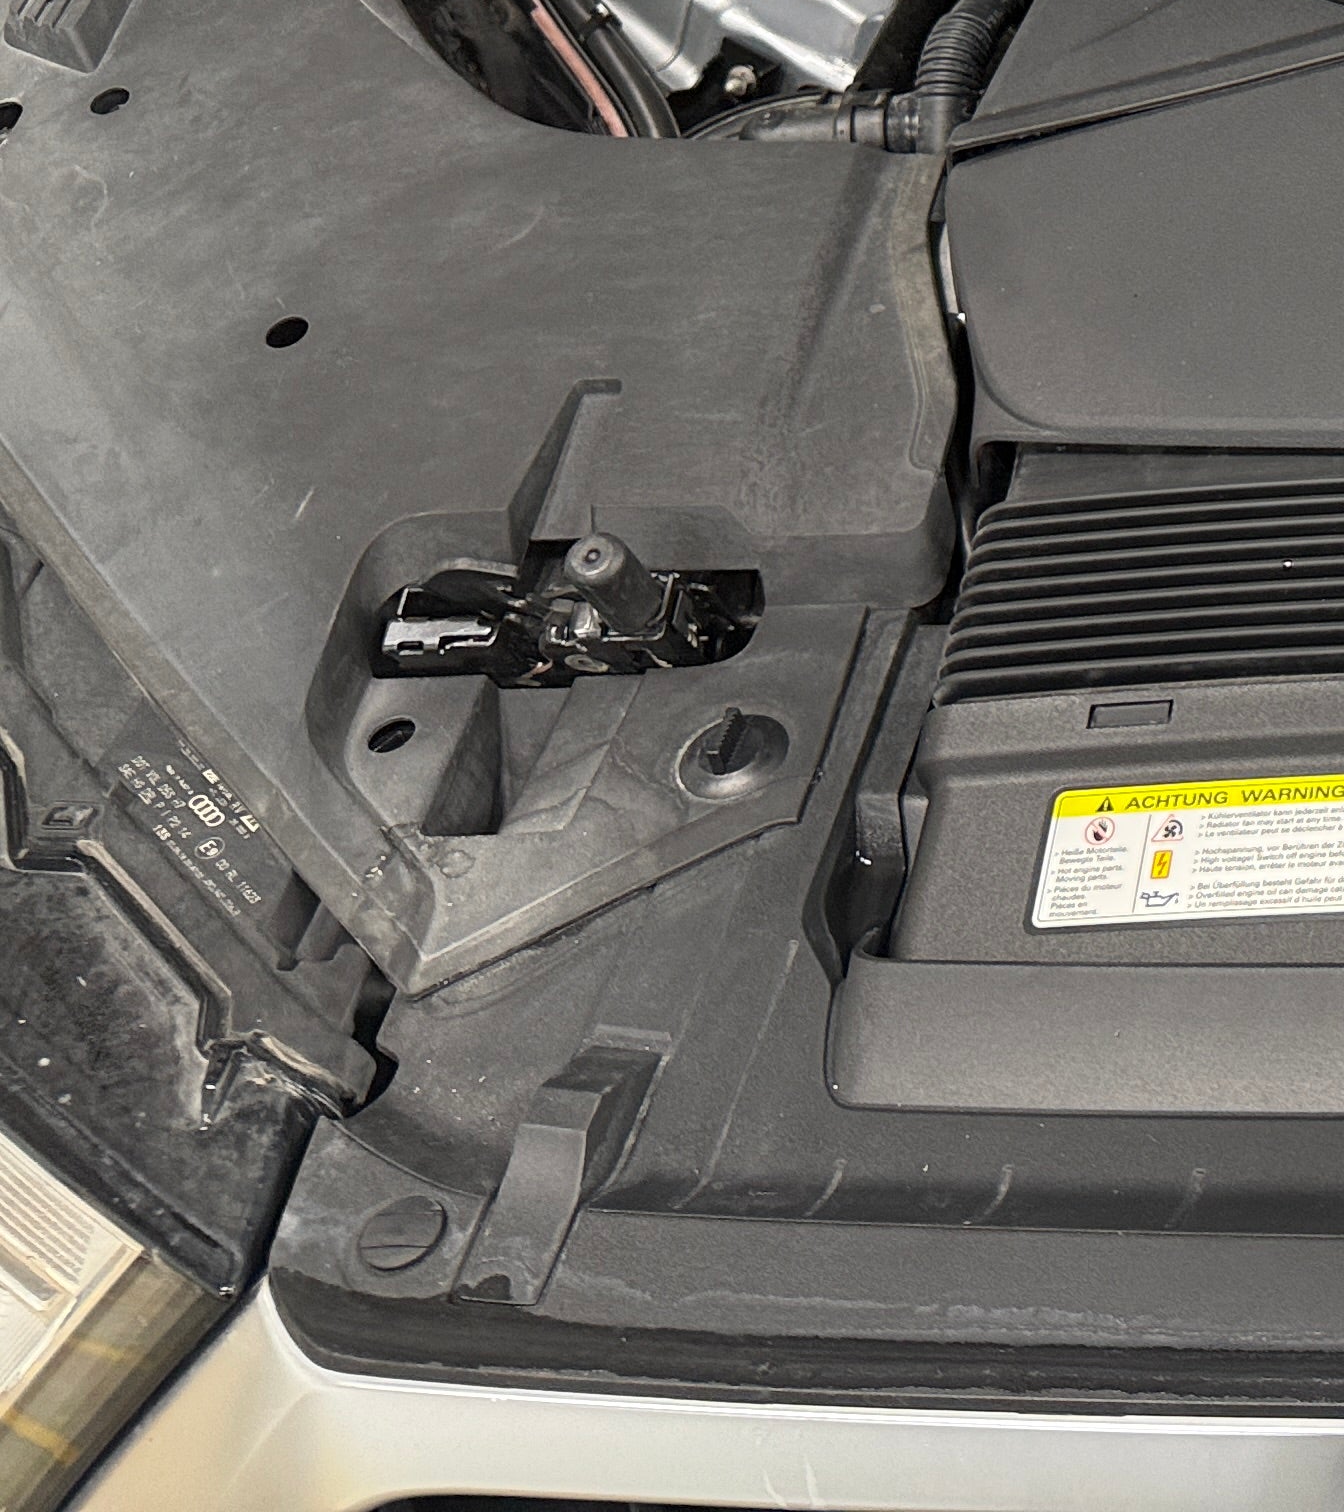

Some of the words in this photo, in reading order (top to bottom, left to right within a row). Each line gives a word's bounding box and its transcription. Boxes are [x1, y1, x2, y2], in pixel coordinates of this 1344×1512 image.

[1126, 793, 1228, 809] ACHTUNG
[1206, 820, 1239, 828] Radiator
[1199, 856, 1219, 864] High
[1298, 851, 1326, 860] engine
[1236, 890, 1264, 898] engine
